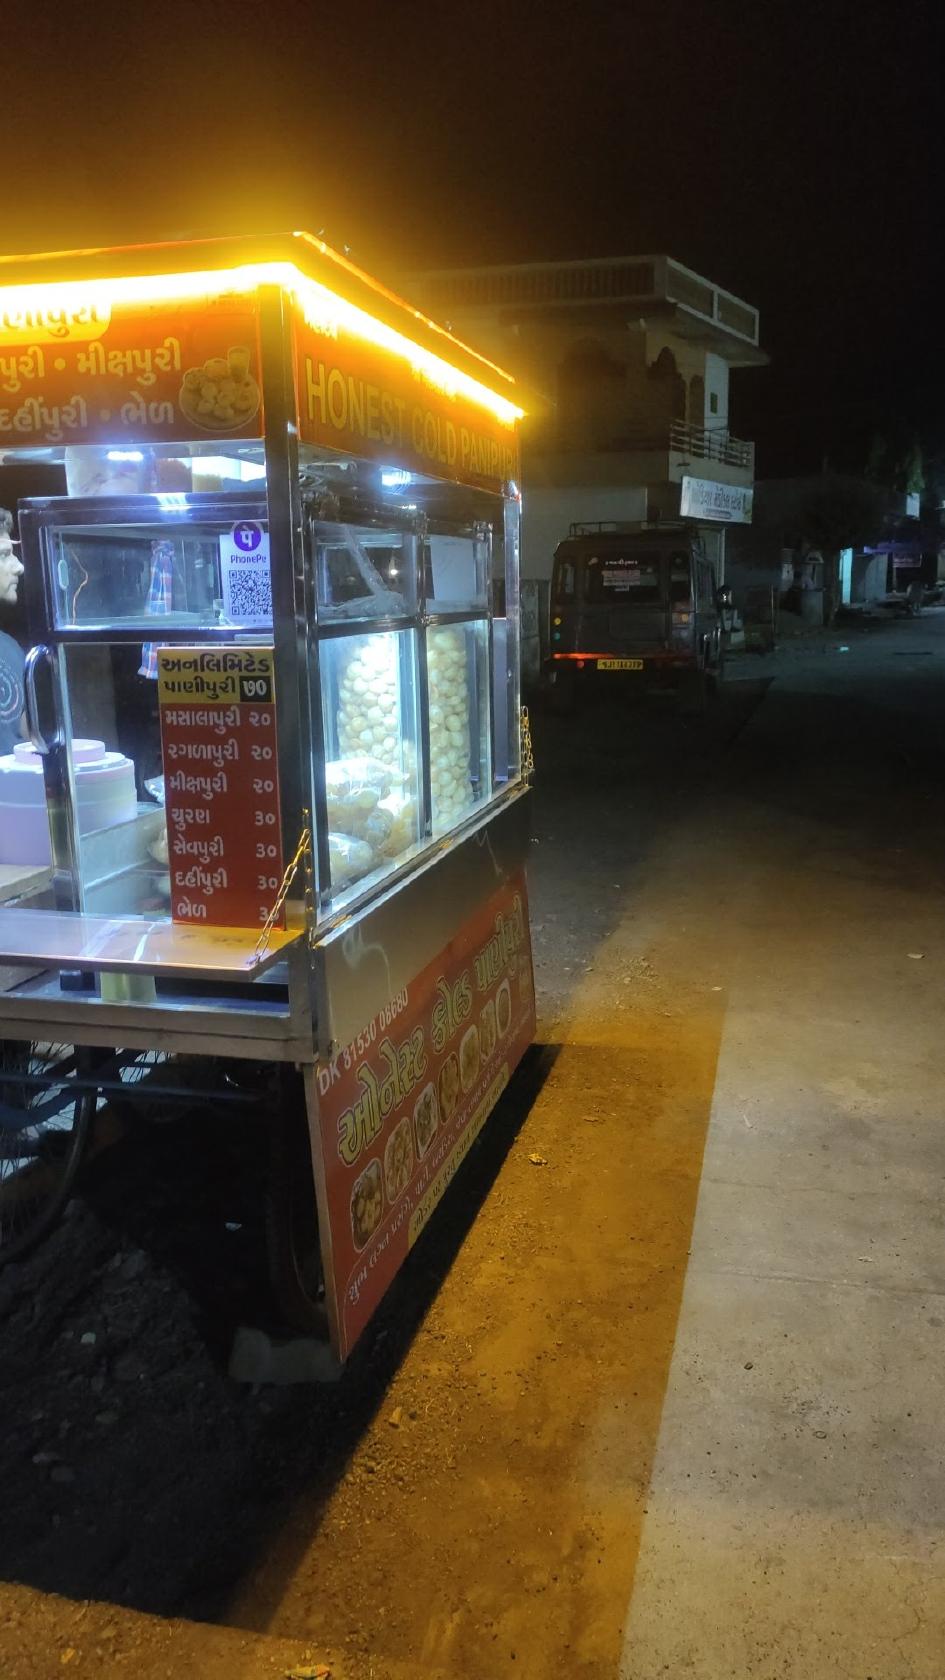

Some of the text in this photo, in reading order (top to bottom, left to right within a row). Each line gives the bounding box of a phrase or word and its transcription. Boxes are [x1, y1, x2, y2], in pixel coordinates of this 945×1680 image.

[121, 390, 175, 425] ભેળ
[305, 358, 407, 447] HONEST
[229, 553, 267, 564] PhonePe
[161, 652, 270, 673] અનલિમિટેડ
[163, 676, 236, 699] પાણીપુરી
[165, 705, 241, 735] મસાલાપુરી
[167, 738, 239, 767] રગળાપુરી
[169, 770, 228, 800] મીક્ષપુરી
[171, 807, 210, 831] ચુરણ
[173, 834, 224, 864] સેવપુરી
[175, 866, 228, 895] દહીંપુરી
[177, 896, 207, 918] ભેળ
[318, 988, 409, 1096] DK 81530 08680
[337, 1025, 427, 1168] ઓનેસ્ટ
[431, 969, 474, 1055] કોલ્ડ
